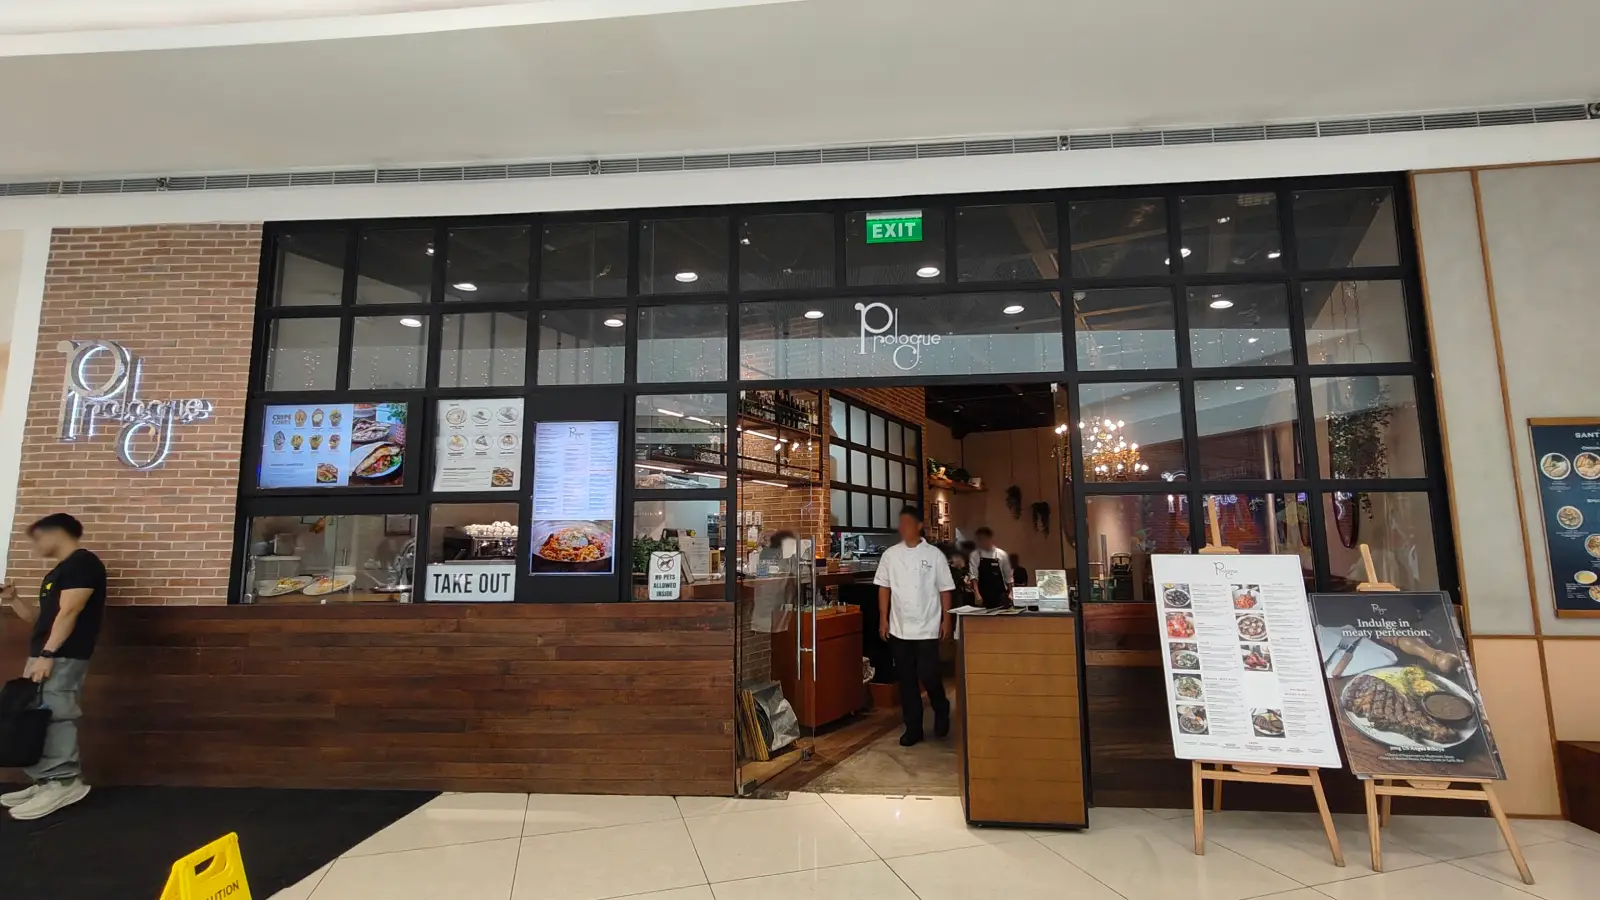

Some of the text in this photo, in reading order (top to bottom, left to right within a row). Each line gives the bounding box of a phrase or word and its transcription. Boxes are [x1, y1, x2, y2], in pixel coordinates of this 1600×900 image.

[872, 222, 916, 239] EXIT
[854, 302, 941, 370] Prologue
[56, 339, 213, 472] Prologue
[433, 573, 511, 593] TAKE OUT
[1357, 618, 1410, 629] Indulge in
[1342, 628, 1431, 638] meaty perfection.
